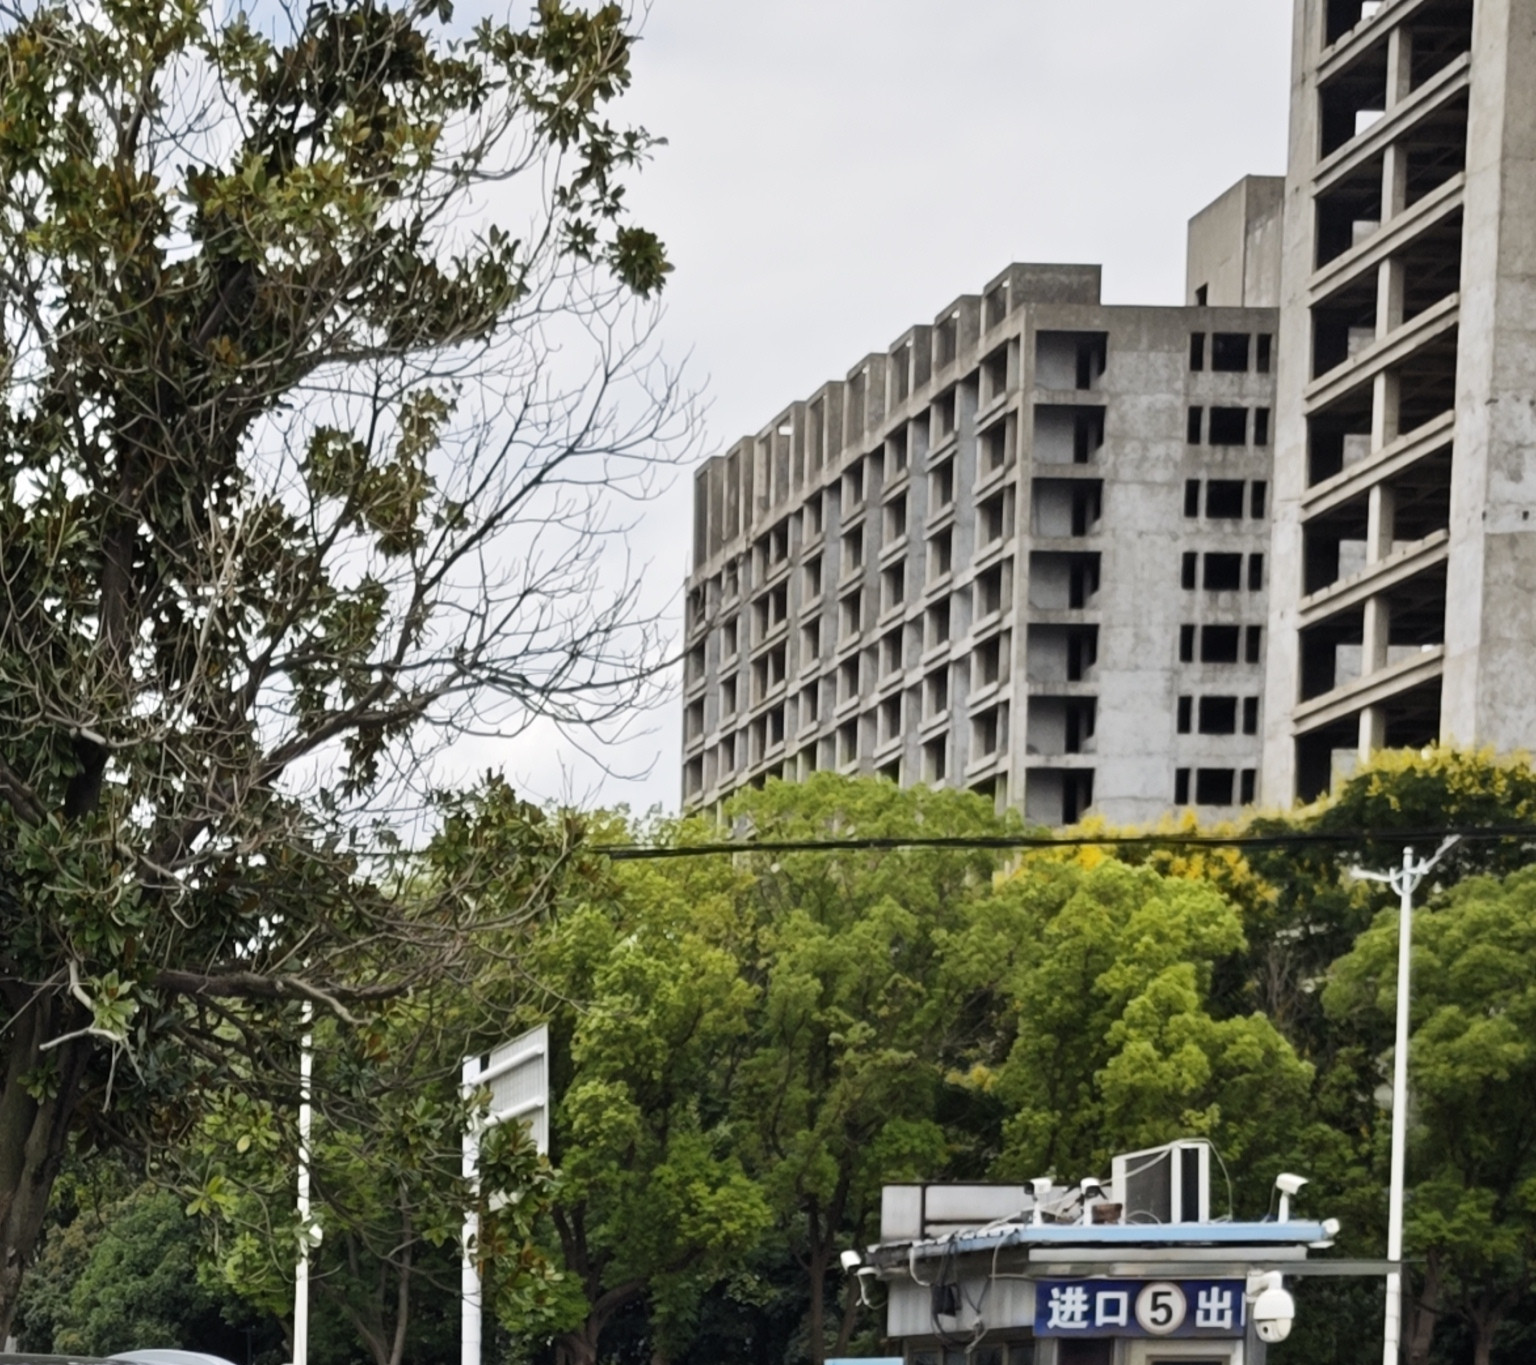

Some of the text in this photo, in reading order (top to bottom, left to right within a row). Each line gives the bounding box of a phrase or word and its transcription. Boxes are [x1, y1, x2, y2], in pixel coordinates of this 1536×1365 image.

[1047, 1286, 1247, 1329] 进口 5 出
